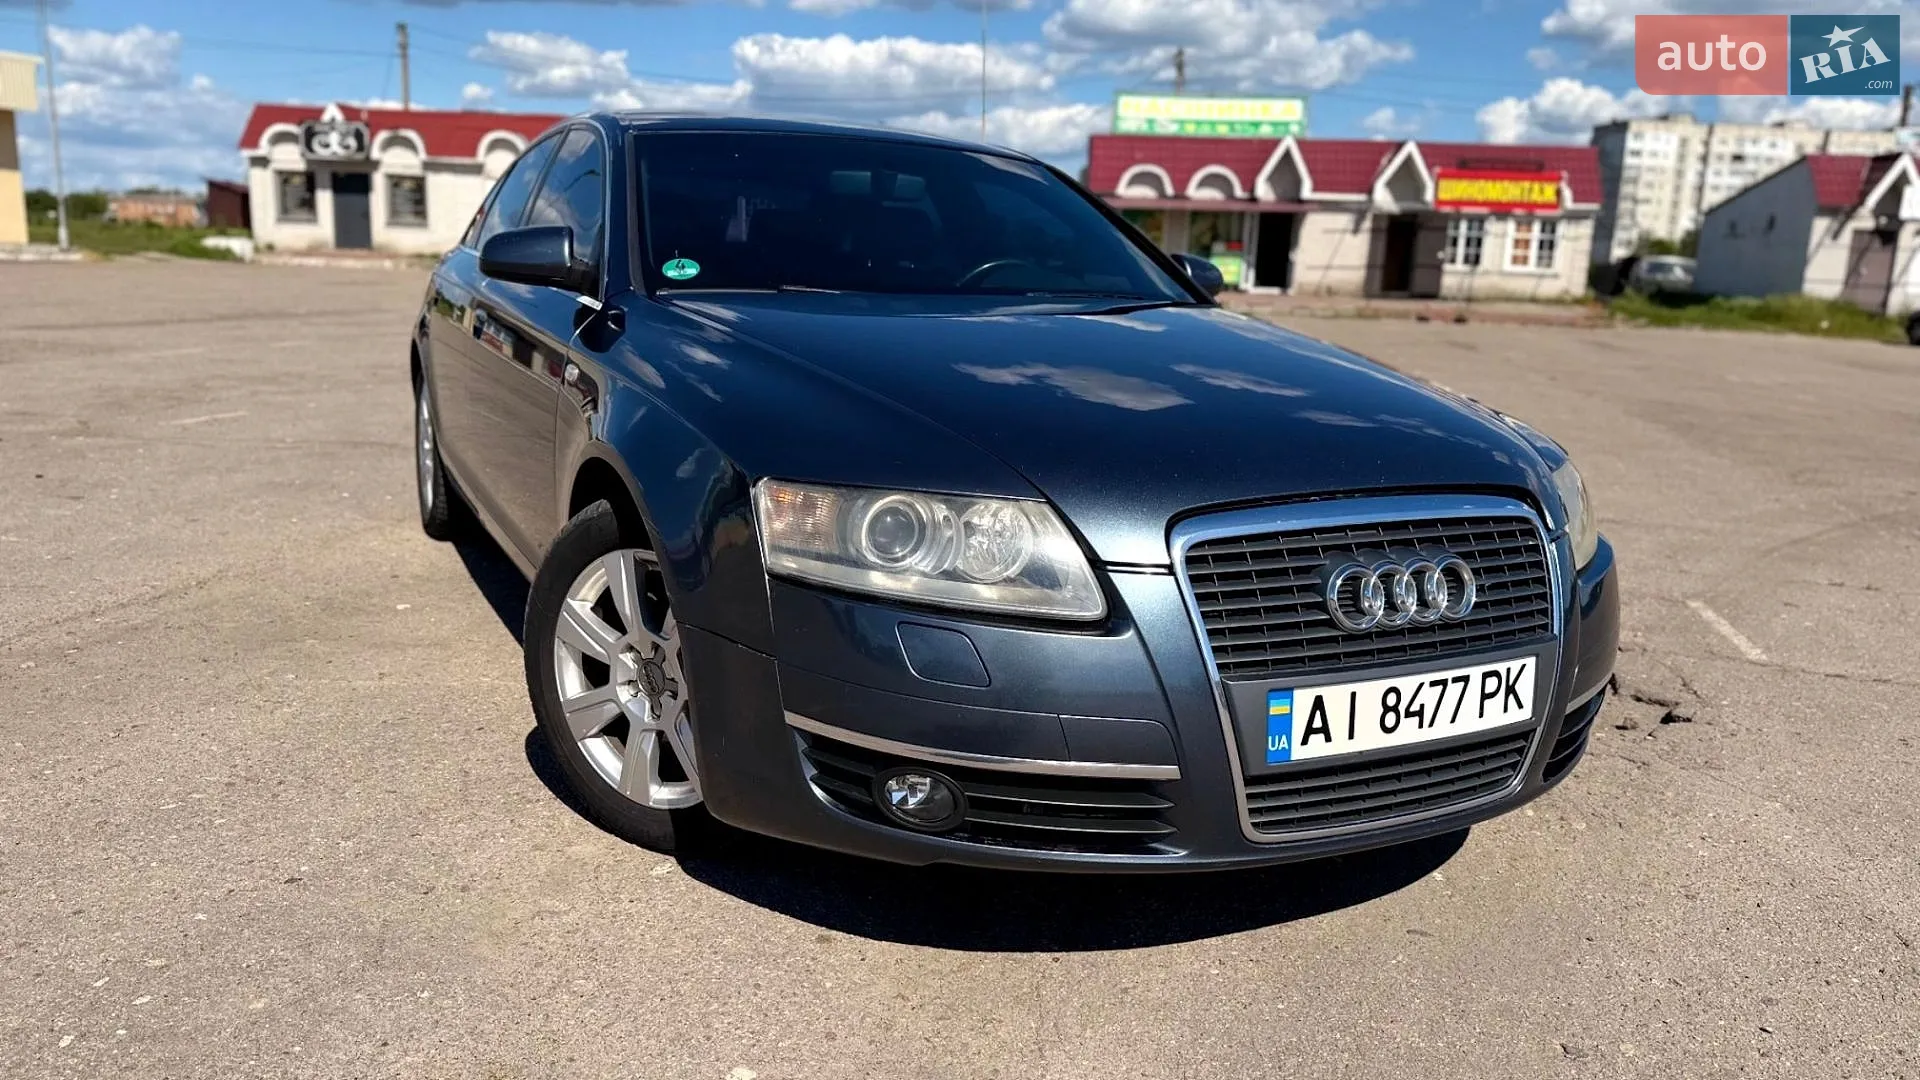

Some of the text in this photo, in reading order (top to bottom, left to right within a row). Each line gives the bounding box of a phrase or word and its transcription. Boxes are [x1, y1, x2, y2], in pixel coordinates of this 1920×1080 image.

[1300, 663, 1527, 746] AI 8477 PK
[1268, 735, 1289, 751] UA
